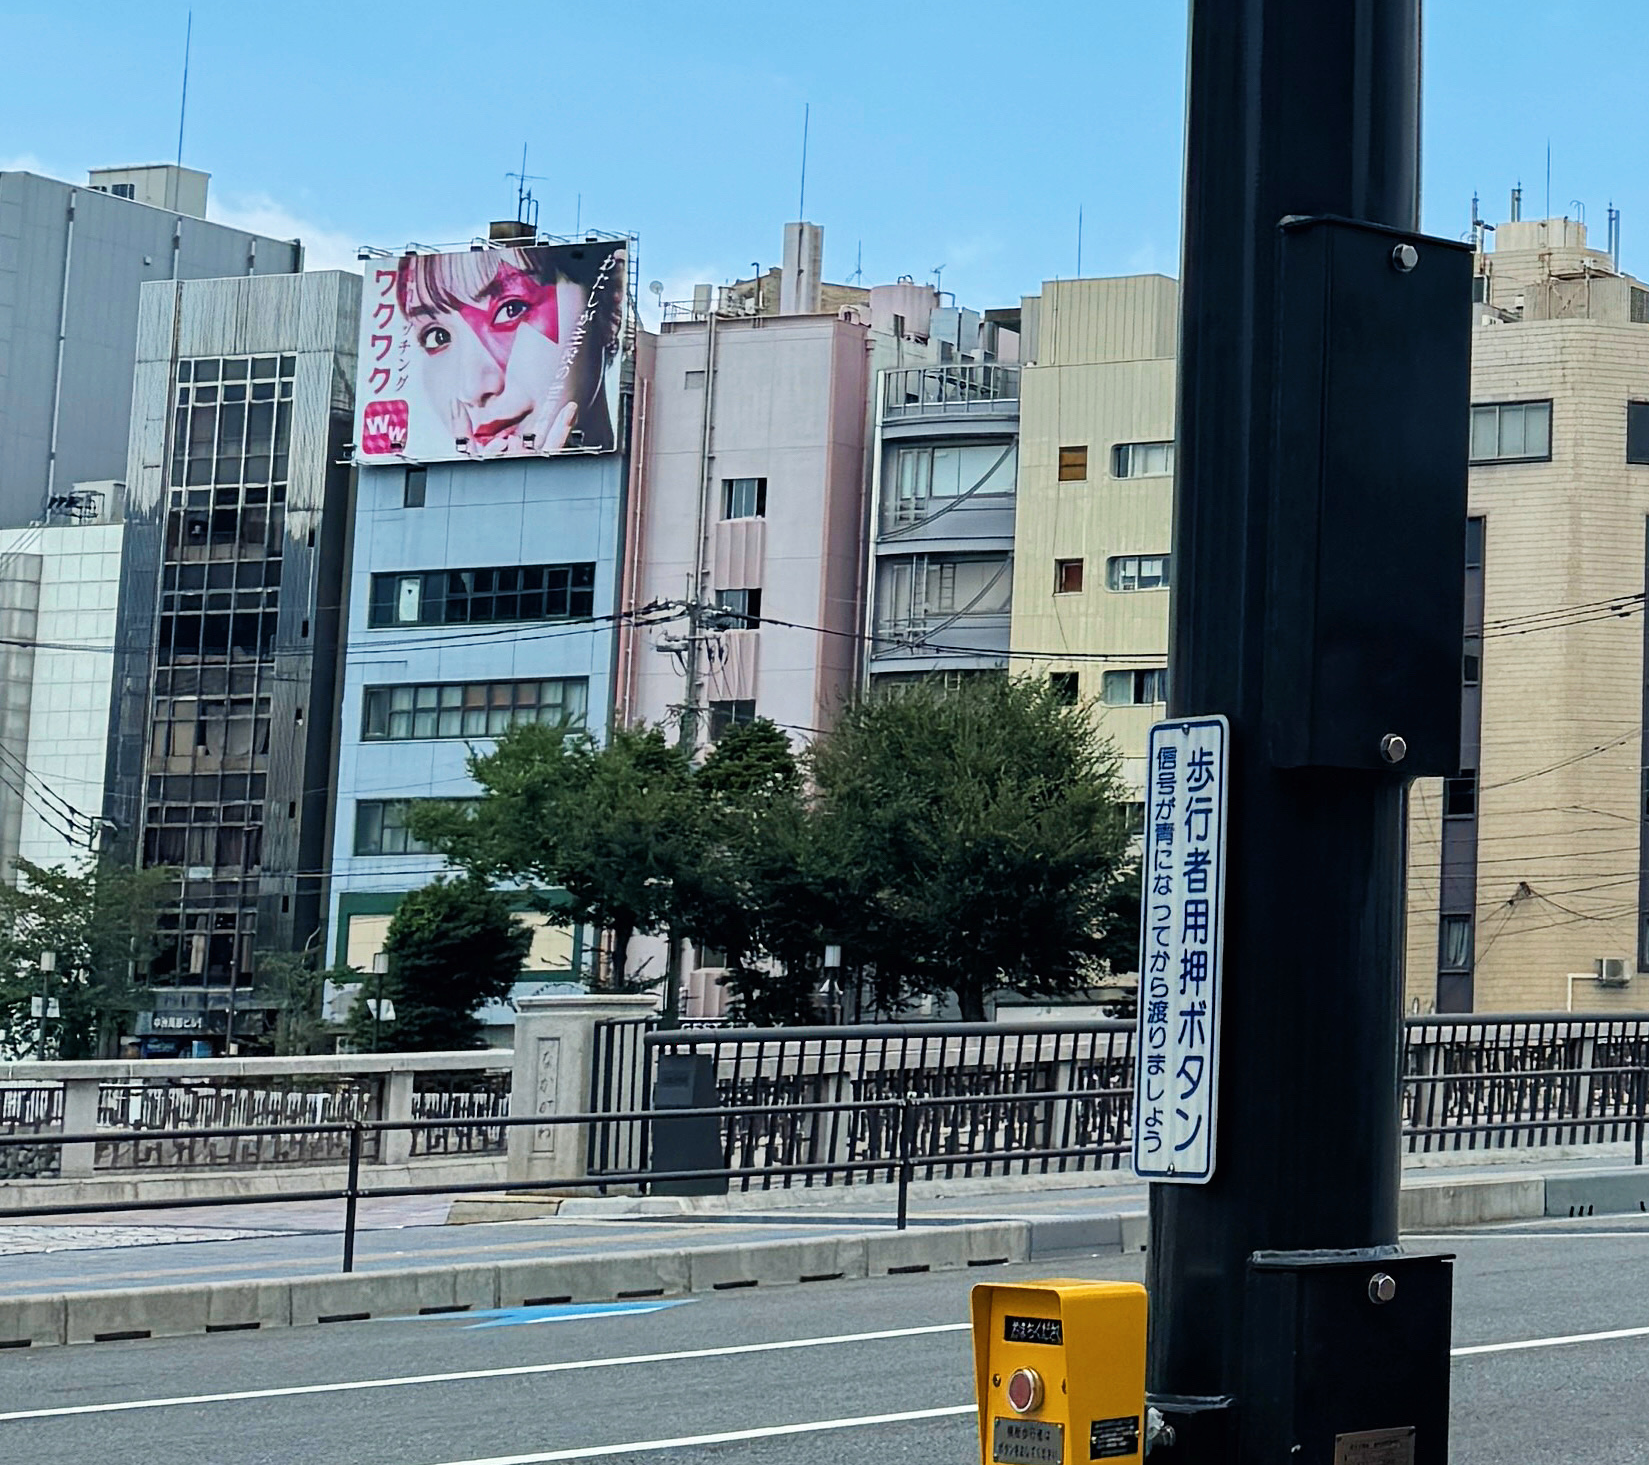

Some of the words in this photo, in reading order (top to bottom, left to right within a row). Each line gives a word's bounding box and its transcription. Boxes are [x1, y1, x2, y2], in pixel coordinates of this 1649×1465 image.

[367, 269, 398, 395] ワクワク
[1143, 746, 1178, 1154] 信号が青になってから渡りましょう
[1174, 746, 1215, 1152] 歩行者用押ボタン
